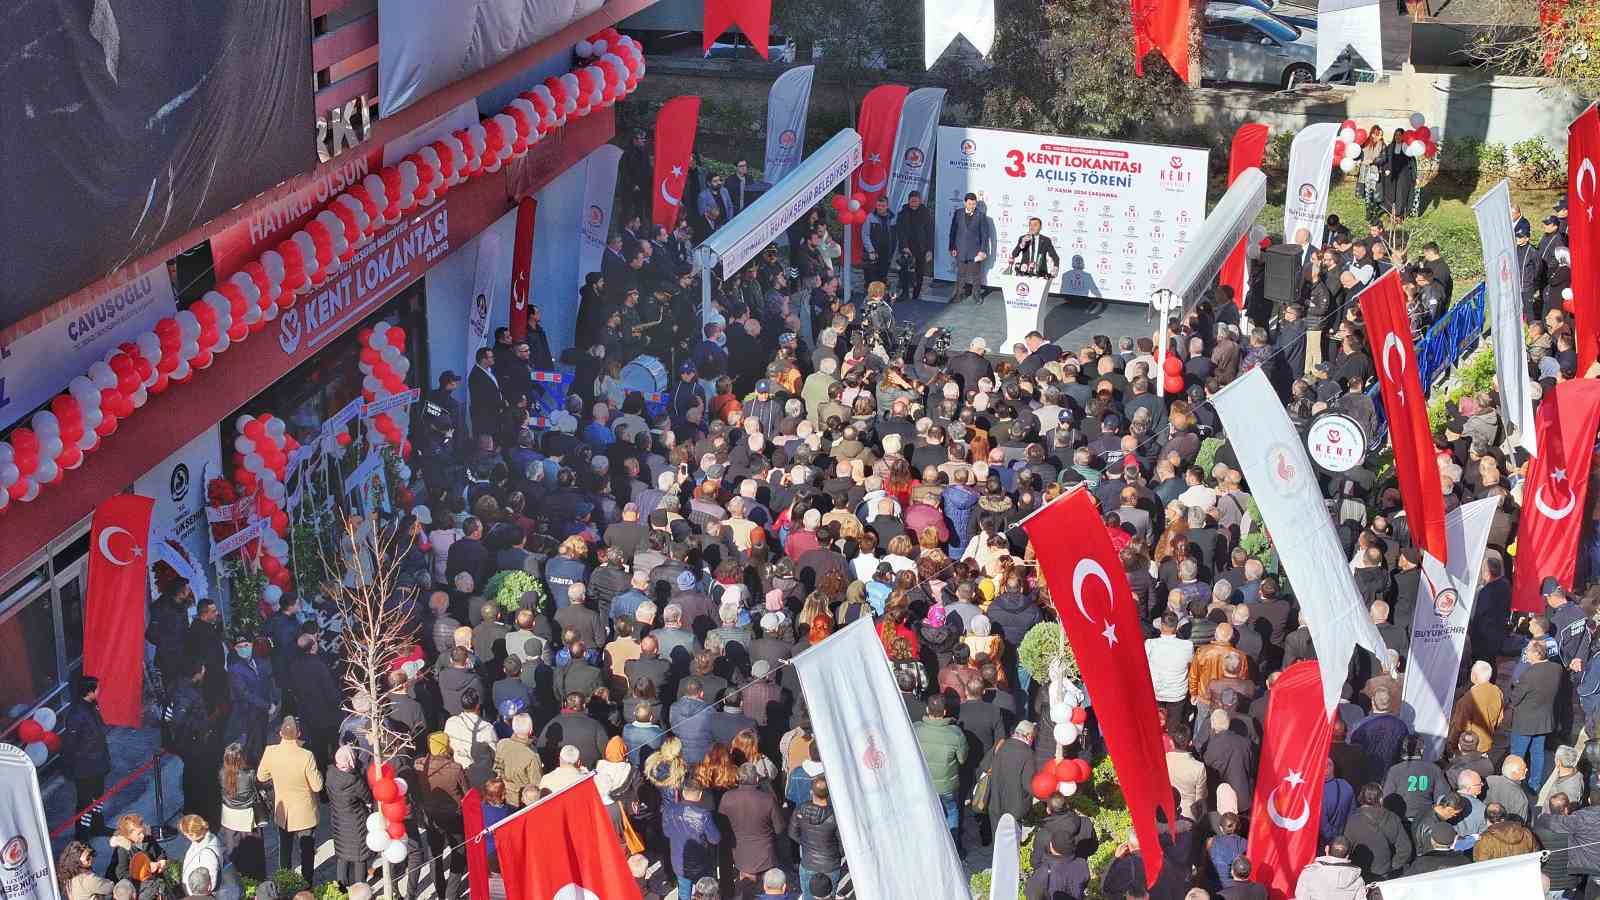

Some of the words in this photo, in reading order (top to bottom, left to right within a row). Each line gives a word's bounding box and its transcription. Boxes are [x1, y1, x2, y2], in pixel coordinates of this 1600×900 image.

[1027, 152, 1061, 165] KENT
[1065, 156, 1142, 173] LOKANTASI
[1035, 169, 1076, 185] AÇILIŞ
[1081, 170, 1131, 187] TÖRENİ
[305, 275, 352, 334] KENT
[356, 208, 448, 298] LOKANTASI
[1315, 443, 1352, 456] KENT
[1408, 775, 1428, 792] 20
